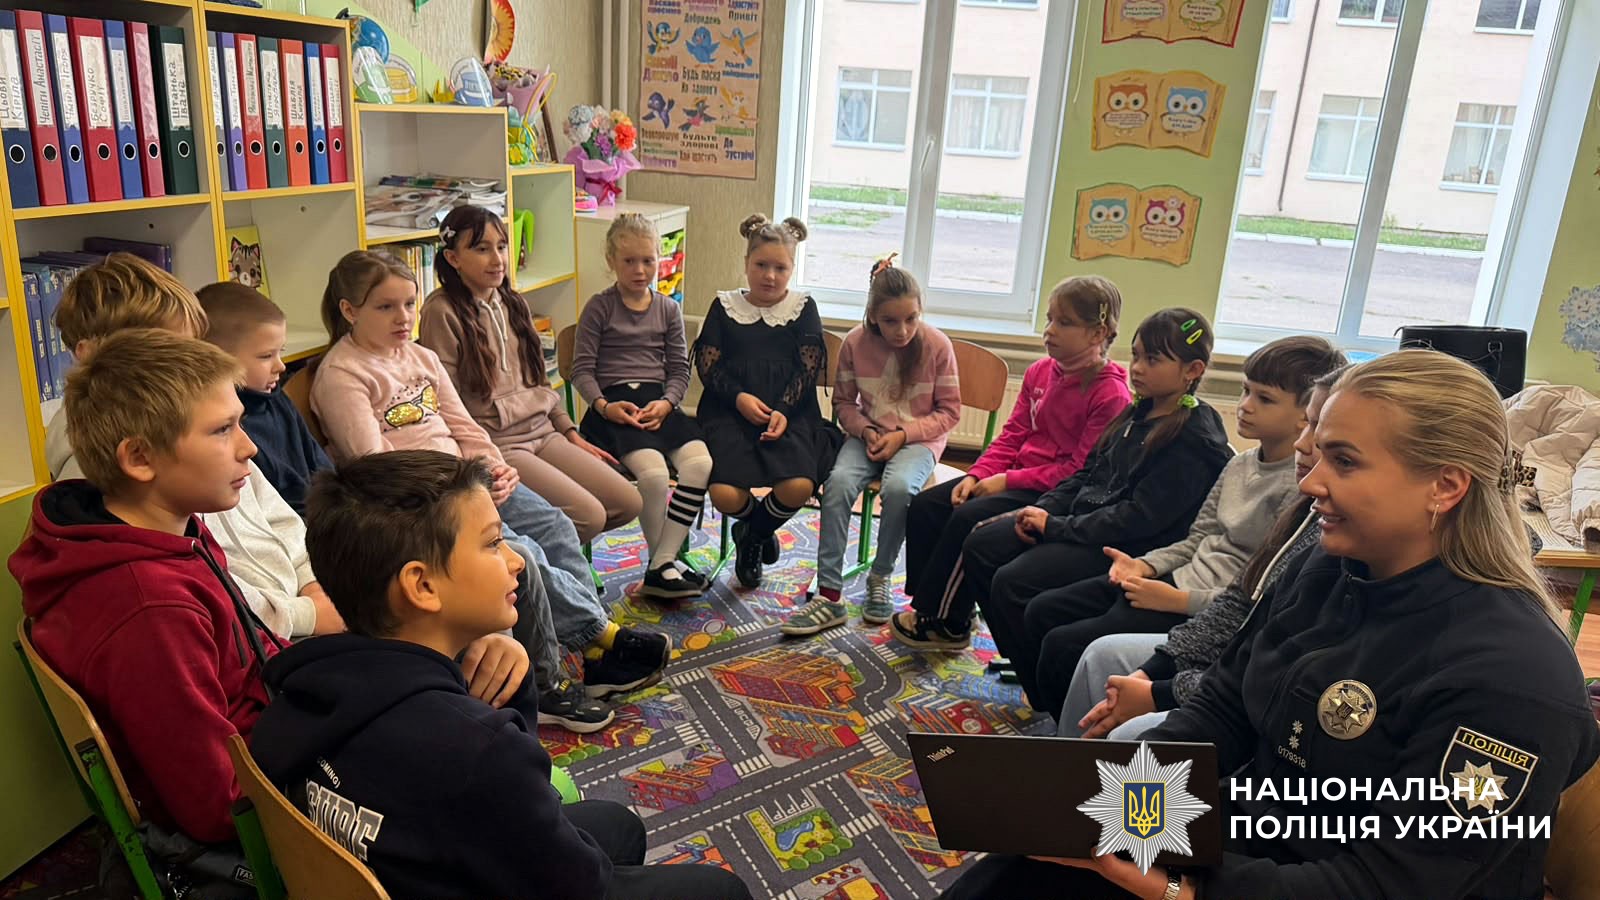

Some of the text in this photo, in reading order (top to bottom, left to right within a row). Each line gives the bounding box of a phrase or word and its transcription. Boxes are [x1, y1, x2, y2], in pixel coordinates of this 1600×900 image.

[728, 11, 758, 22] Привіт
[682, 67, 699, 81] Будь
[169, 62, 180, 118] Штанька
[178, 81, 188, 118] Івана
[723, 137, 734, 149] До
[926, 745, 955, 762] ThinkPad
[1278, 745, 1306, 768] 0179318
[1461, 732, 1529, 767] ПОЛІЦІЯ
